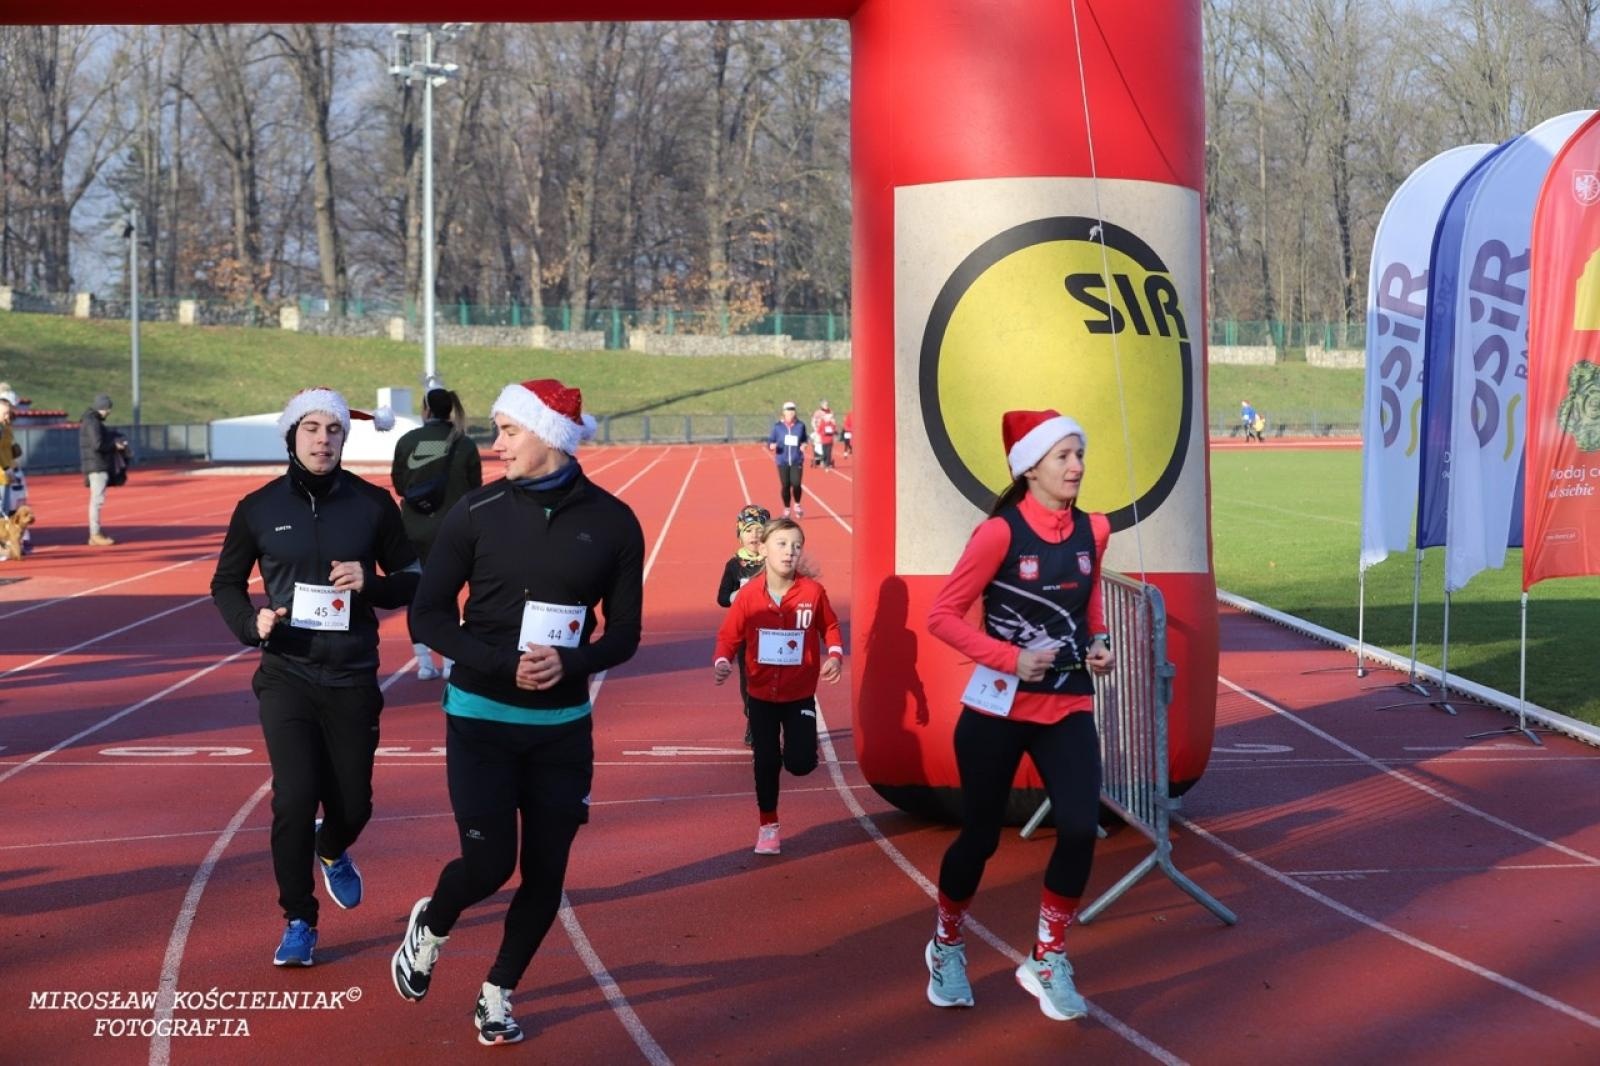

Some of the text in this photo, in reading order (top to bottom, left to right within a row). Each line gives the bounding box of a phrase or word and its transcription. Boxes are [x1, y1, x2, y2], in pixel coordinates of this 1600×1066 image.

[314, 607, 328, 617] 45
[796, 609, 812, 630] 10
[547, 629, 562, 640] 44
[980, 683, 987, 695] 7
